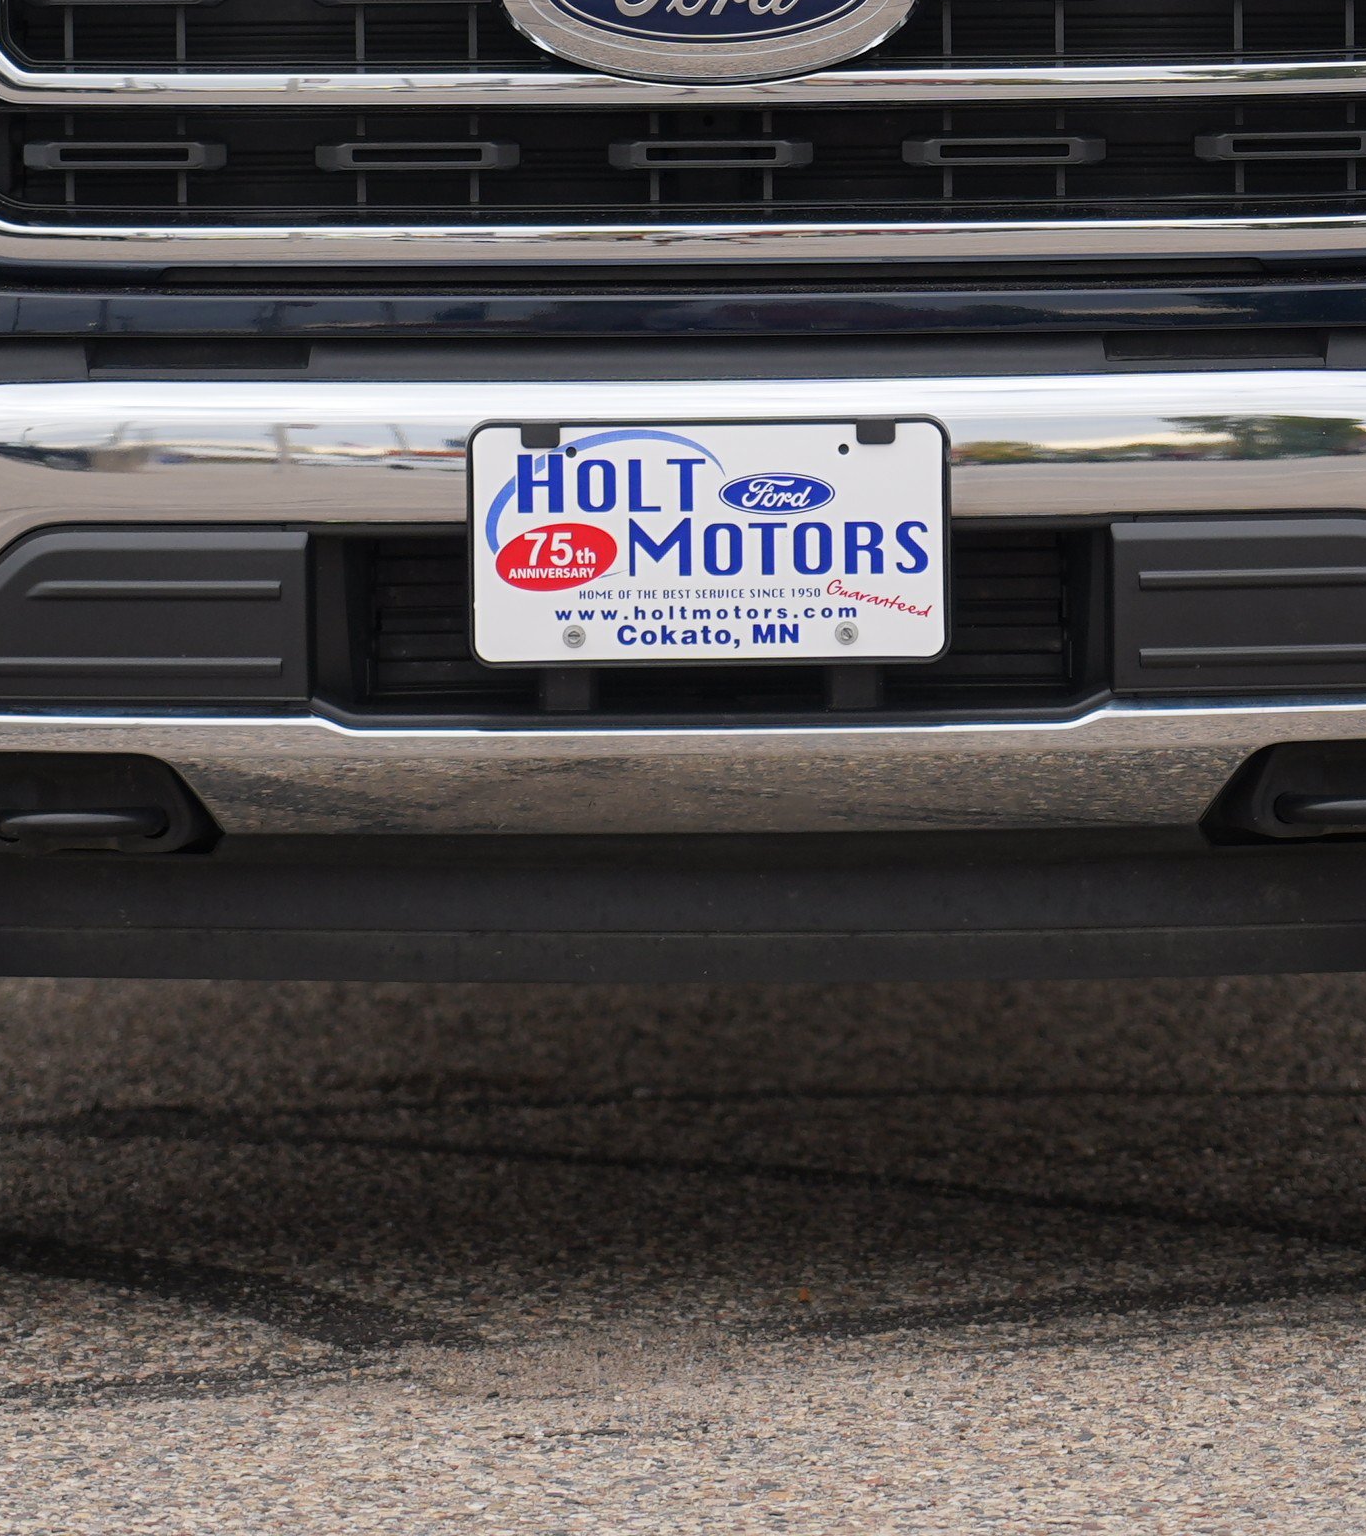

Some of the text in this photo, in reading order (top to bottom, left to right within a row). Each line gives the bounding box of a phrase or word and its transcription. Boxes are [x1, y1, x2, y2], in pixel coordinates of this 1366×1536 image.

[517, 454, 705, 513] HOLT
[742, 480, 812, 508] Ford
[524, 533, 596, 565] 75th
[629, 518, 928, 576] MOTORS
[508, 567, 595, 579] ANNIVERSARY
[579, 588, 820, 599] HOME OF THE BEST SERVICE SINCE 1950
[826, 579, 932, 618] Guaranteed
[555, 606, 857, 620] www.holtmotors.com
[617, 624, 799, 648] Cokato, MN
